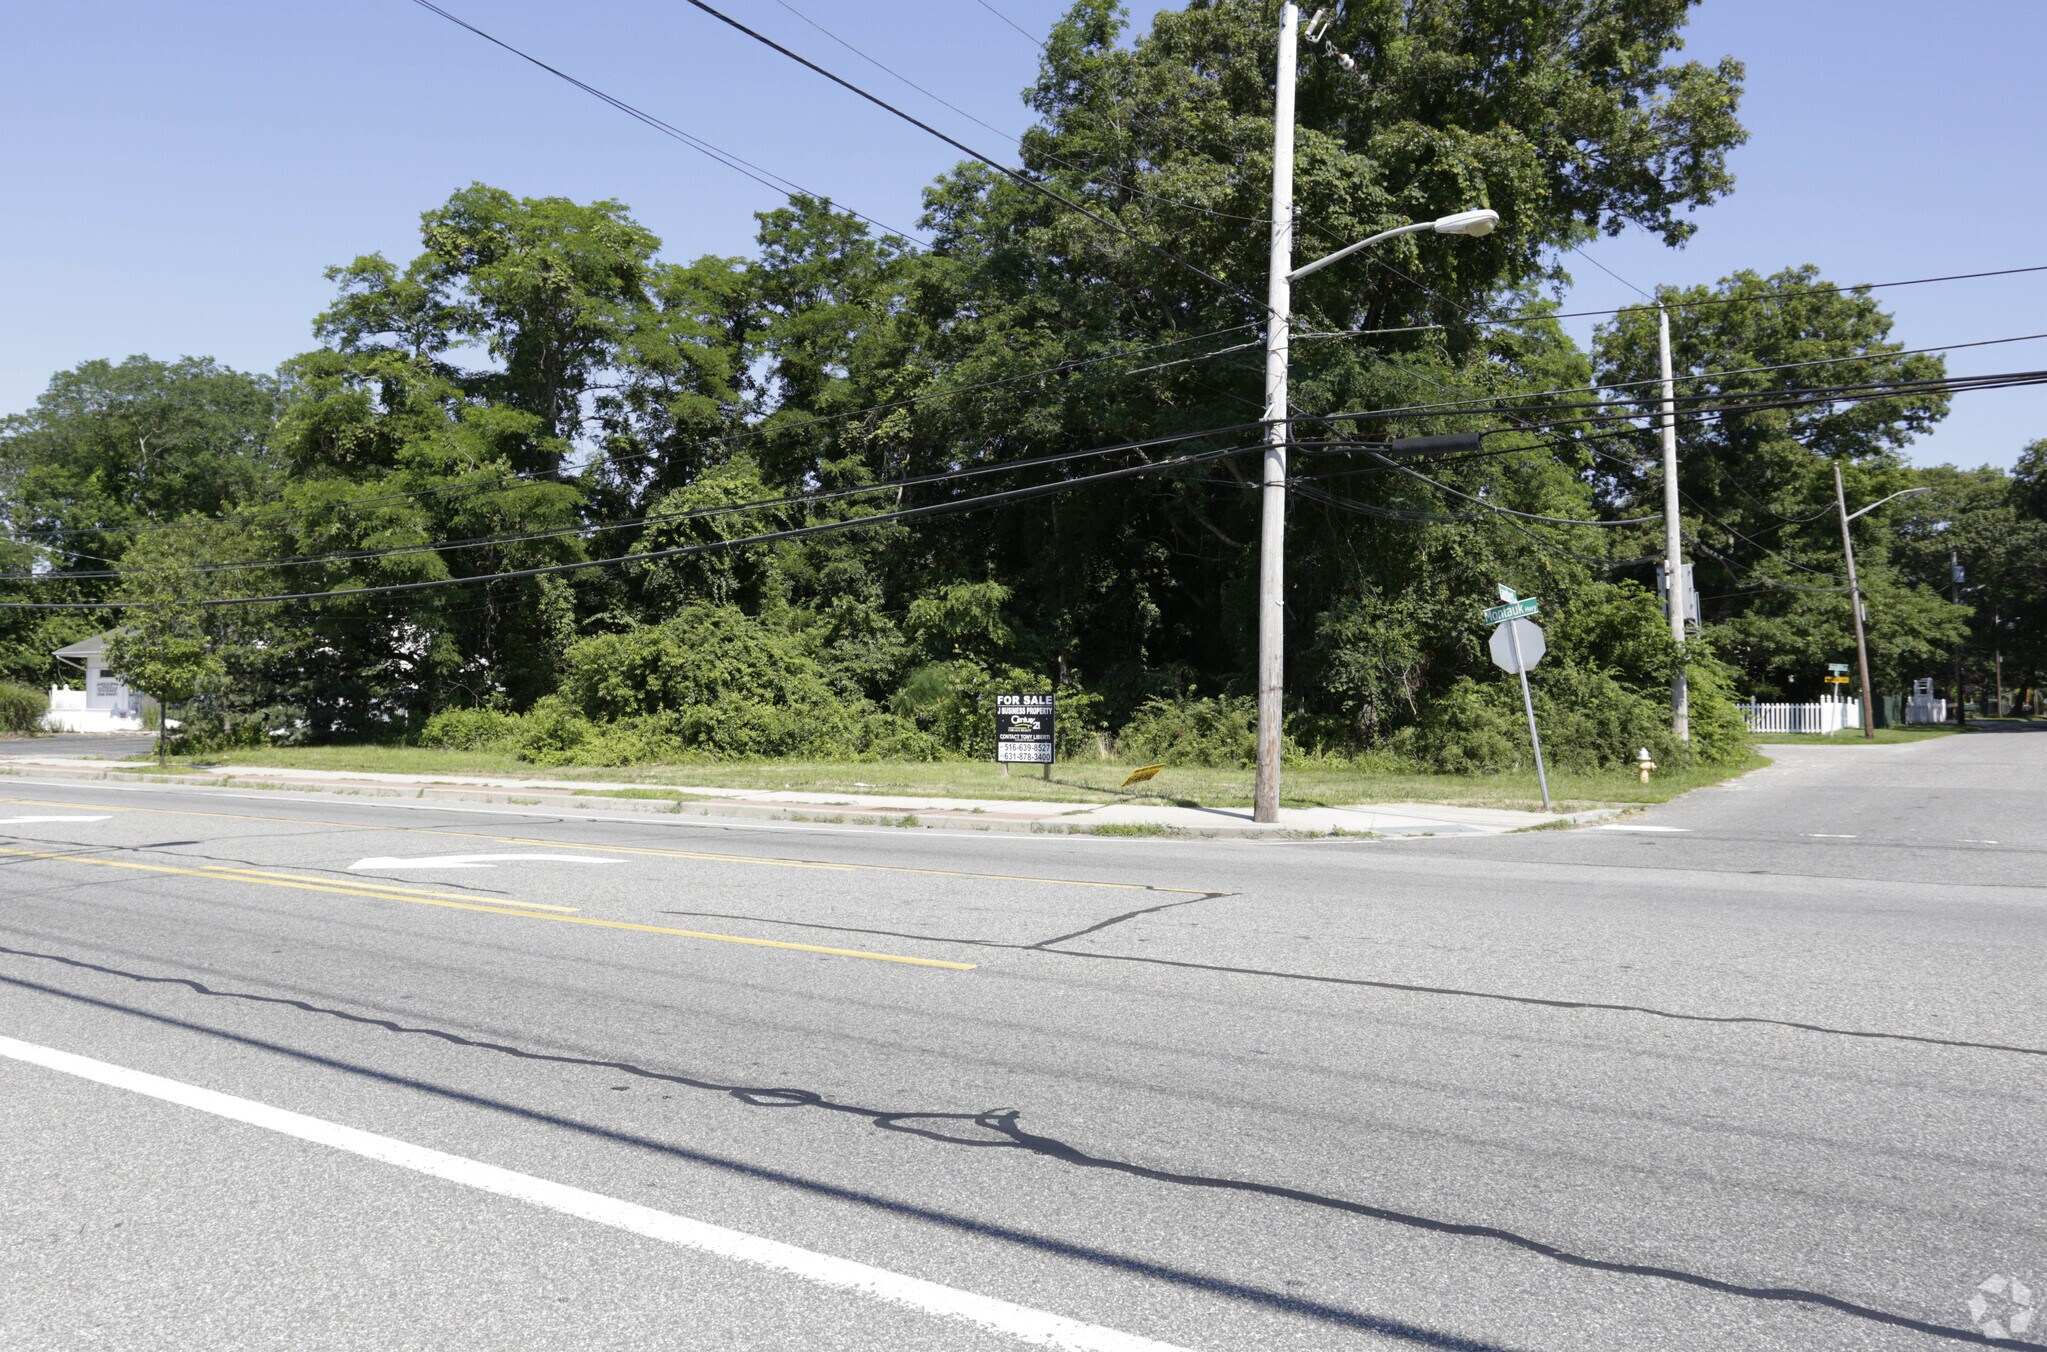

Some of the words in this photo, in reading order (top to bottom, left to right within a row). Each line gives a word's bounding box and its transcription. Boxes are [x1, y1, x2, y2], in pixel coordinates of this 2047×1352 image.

[1484, 602, 1524, 622] Montauk
[997, 695, 1020, 705] FOR
[1023, 695, 1052, 705] SALE
[1002, 707, 1025, 715] BUSINESS
[1027, 707, 1052, 715] PROPERTY
[1033, 721, 1041, 729] 21
[1004, 743, 1050, 752] 516-639-8527
[1004, 753, 1050, 761] 631-878-3400
